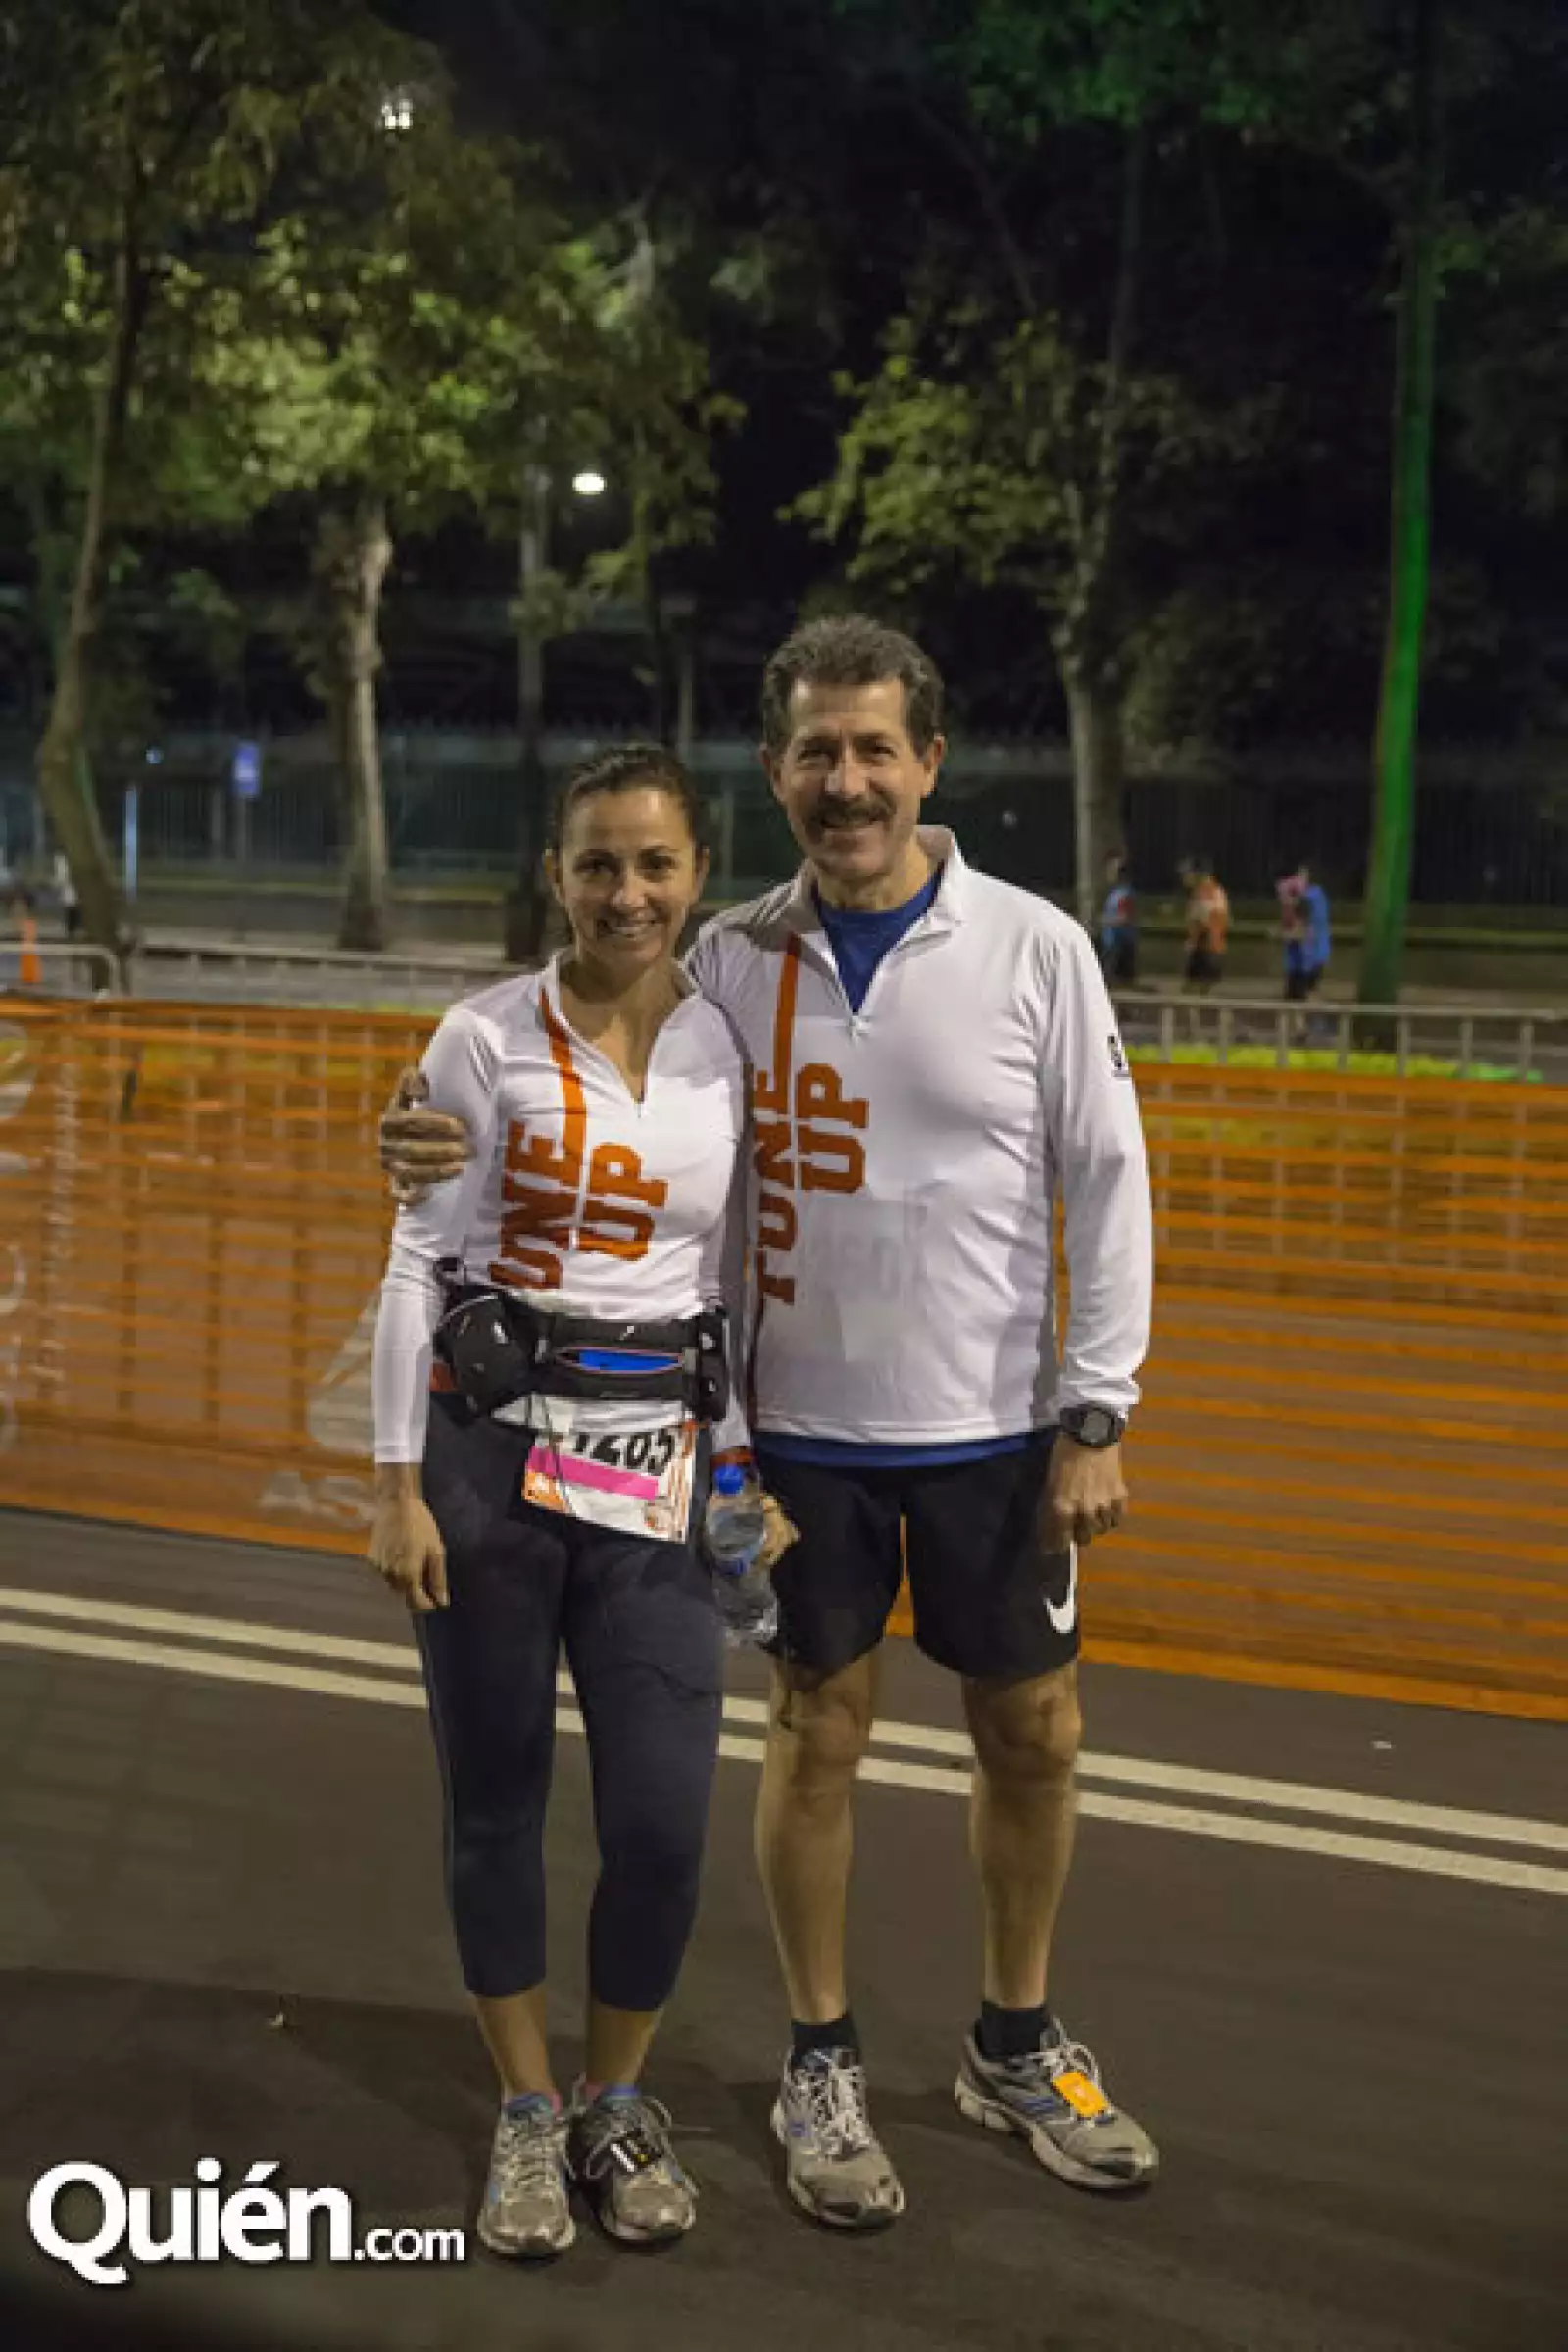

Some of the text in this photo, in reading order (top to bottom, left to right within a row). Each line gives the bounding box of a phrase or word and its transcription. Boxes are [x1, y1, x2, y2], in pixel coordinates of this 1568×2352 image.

[490, 1107, 586, 1290] UNE
[577, 1142, 669, 1261] UP
[754, 1058, 796, 1307] TUNE
[796, 1062, 868, 1193] UP
